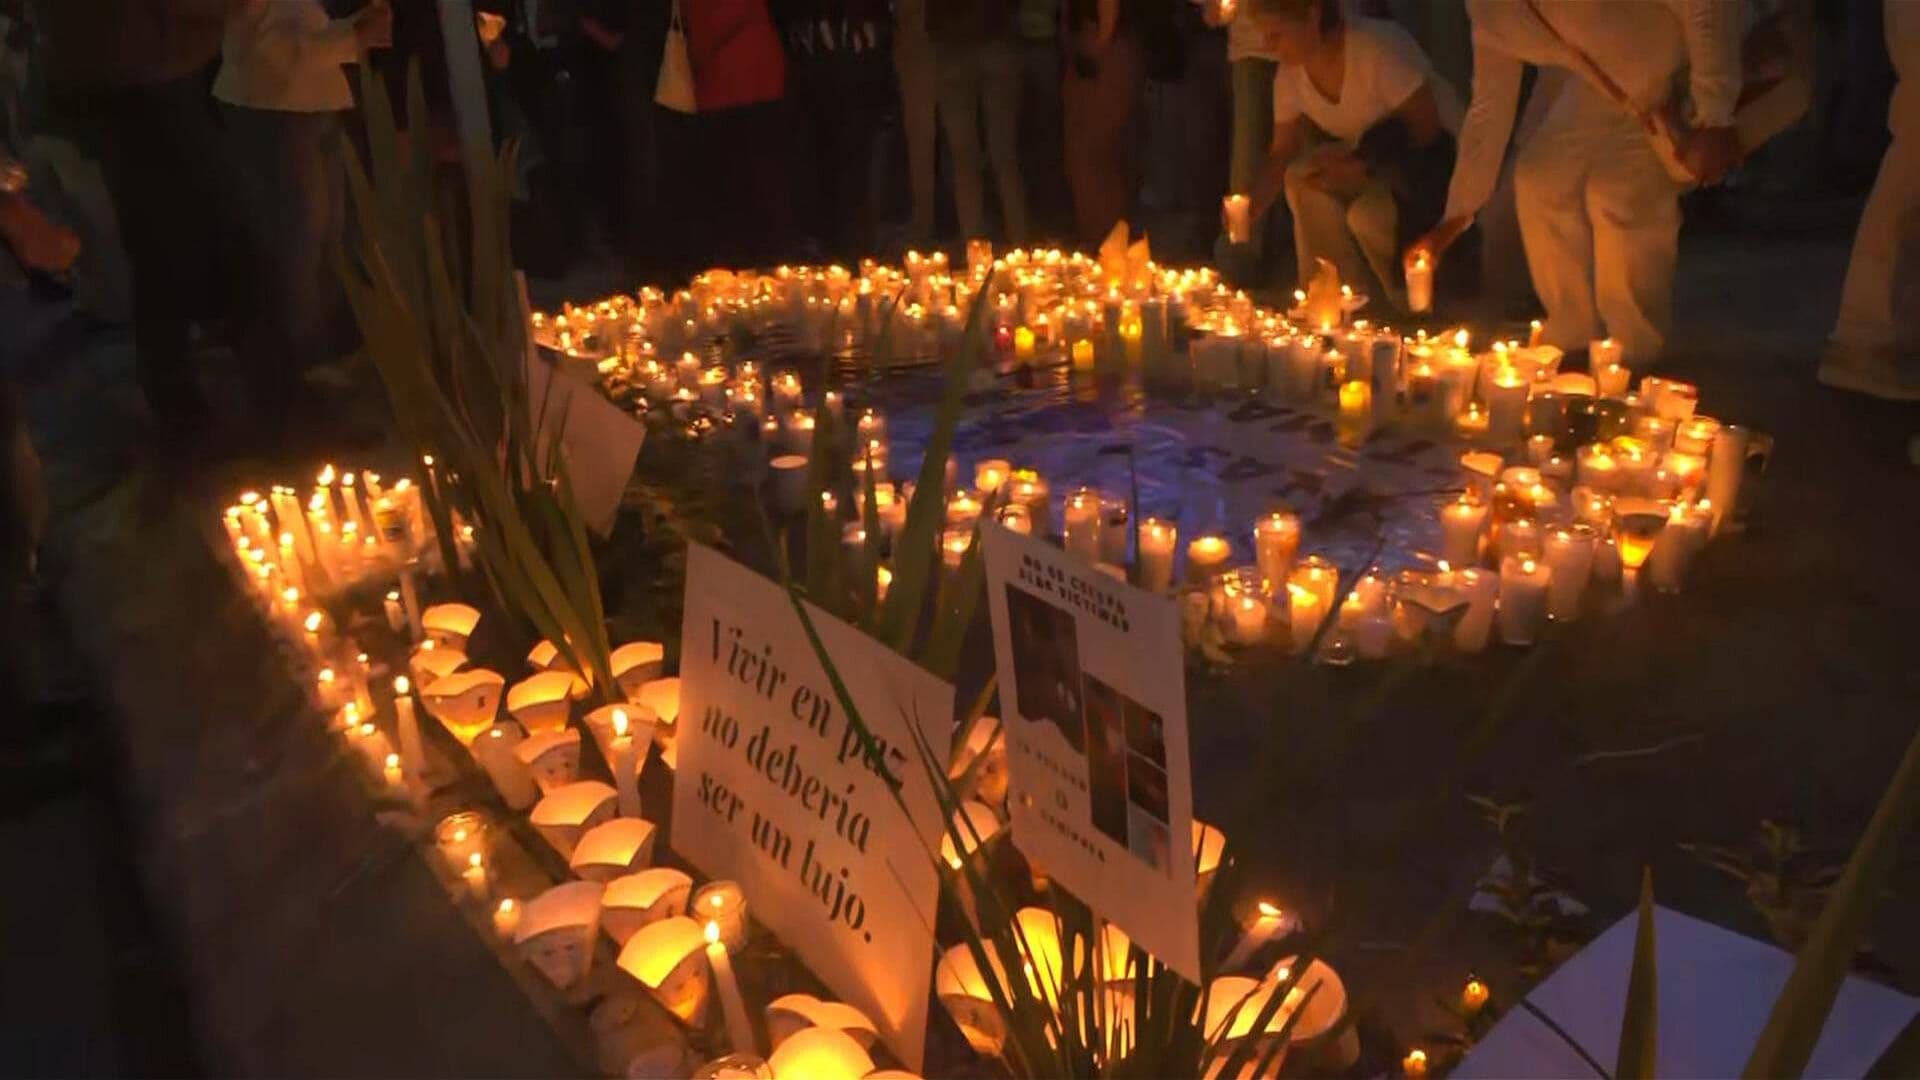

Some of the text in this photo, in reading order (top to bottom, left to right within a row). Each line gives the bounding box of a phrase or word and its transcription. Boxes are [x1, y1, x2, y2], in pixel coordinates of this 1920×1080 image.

[702, 705, 872, 854] no debería
[711, 616, 909, 789] Vivir en paz
[697, 771, 873, 943] ser un lujo.
